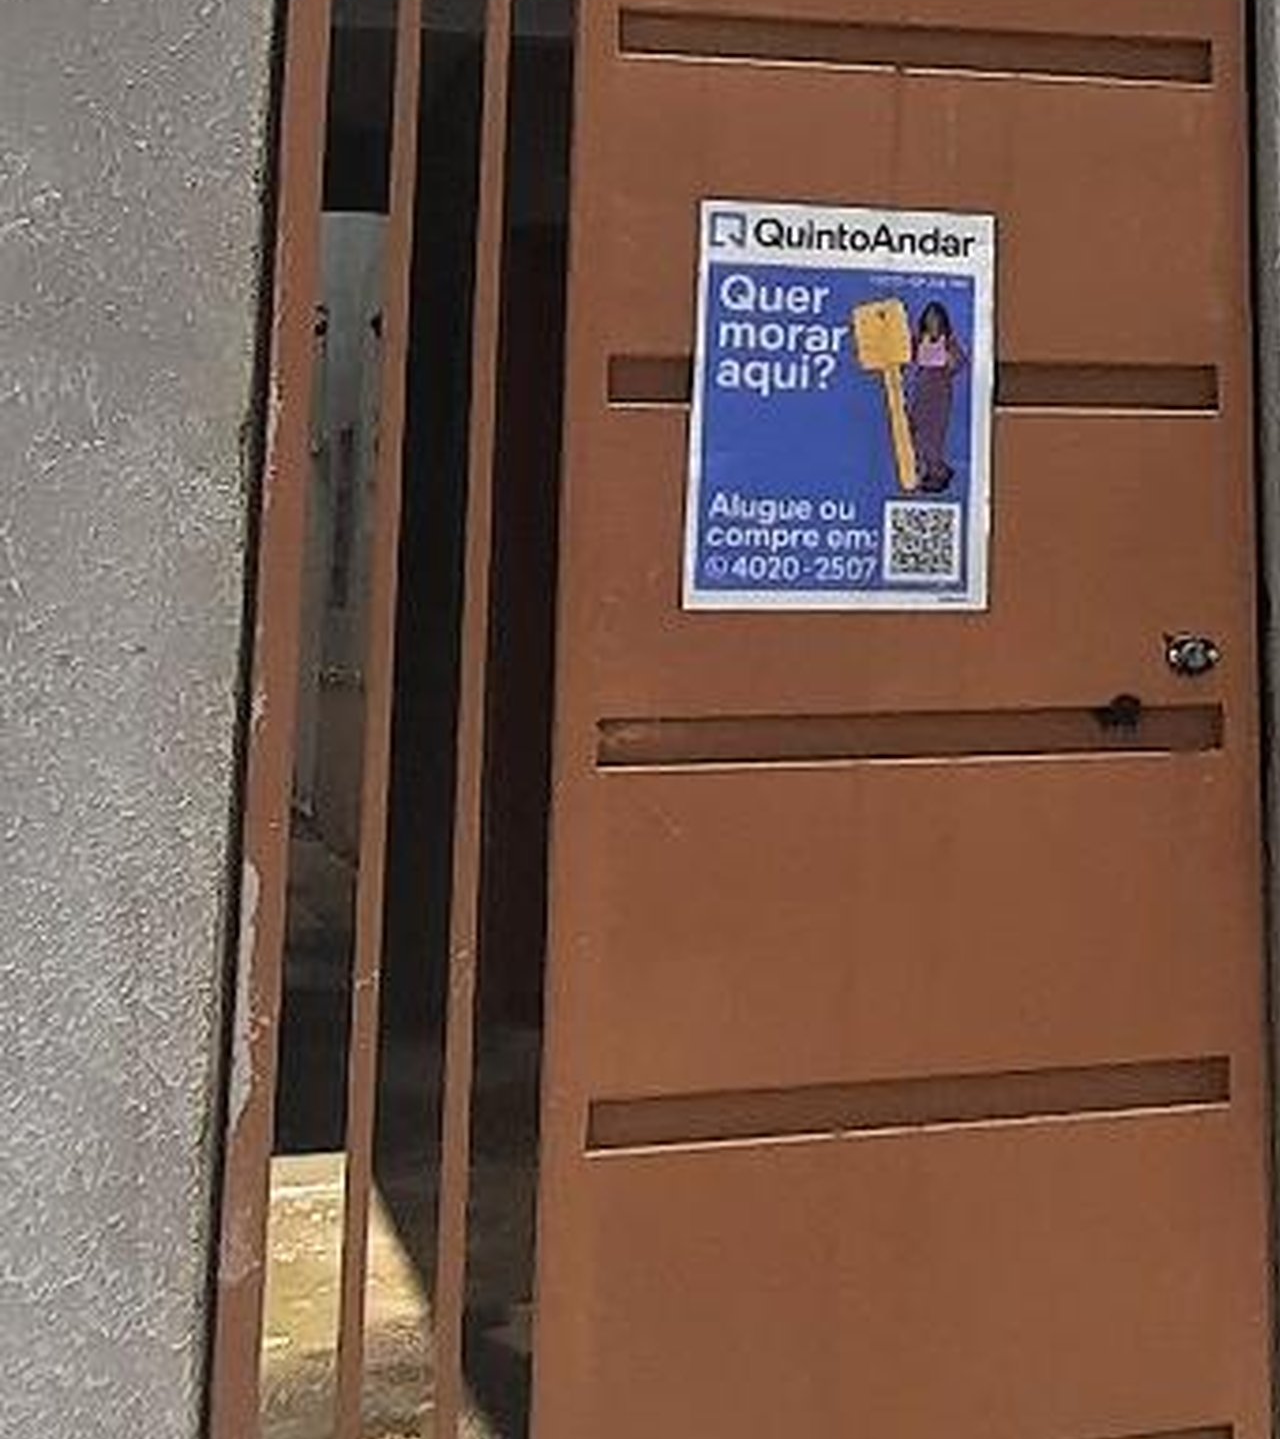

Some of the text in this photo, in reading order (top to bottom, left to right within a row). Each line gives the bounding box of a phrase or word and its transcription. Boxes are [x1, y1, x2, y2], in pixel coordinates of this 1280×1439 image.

[754, 217, 977, 259] QuintoAndar
[719, 273, 830, 315] Quer
[718, 321, 848, 354] morar
[715, 354, 836, 397] aqui?
[708, 492, 856, 524] Alugue ou
[706, 525, 880, 552] compre em:
[730, 554, 878, 581] 4020-2507
